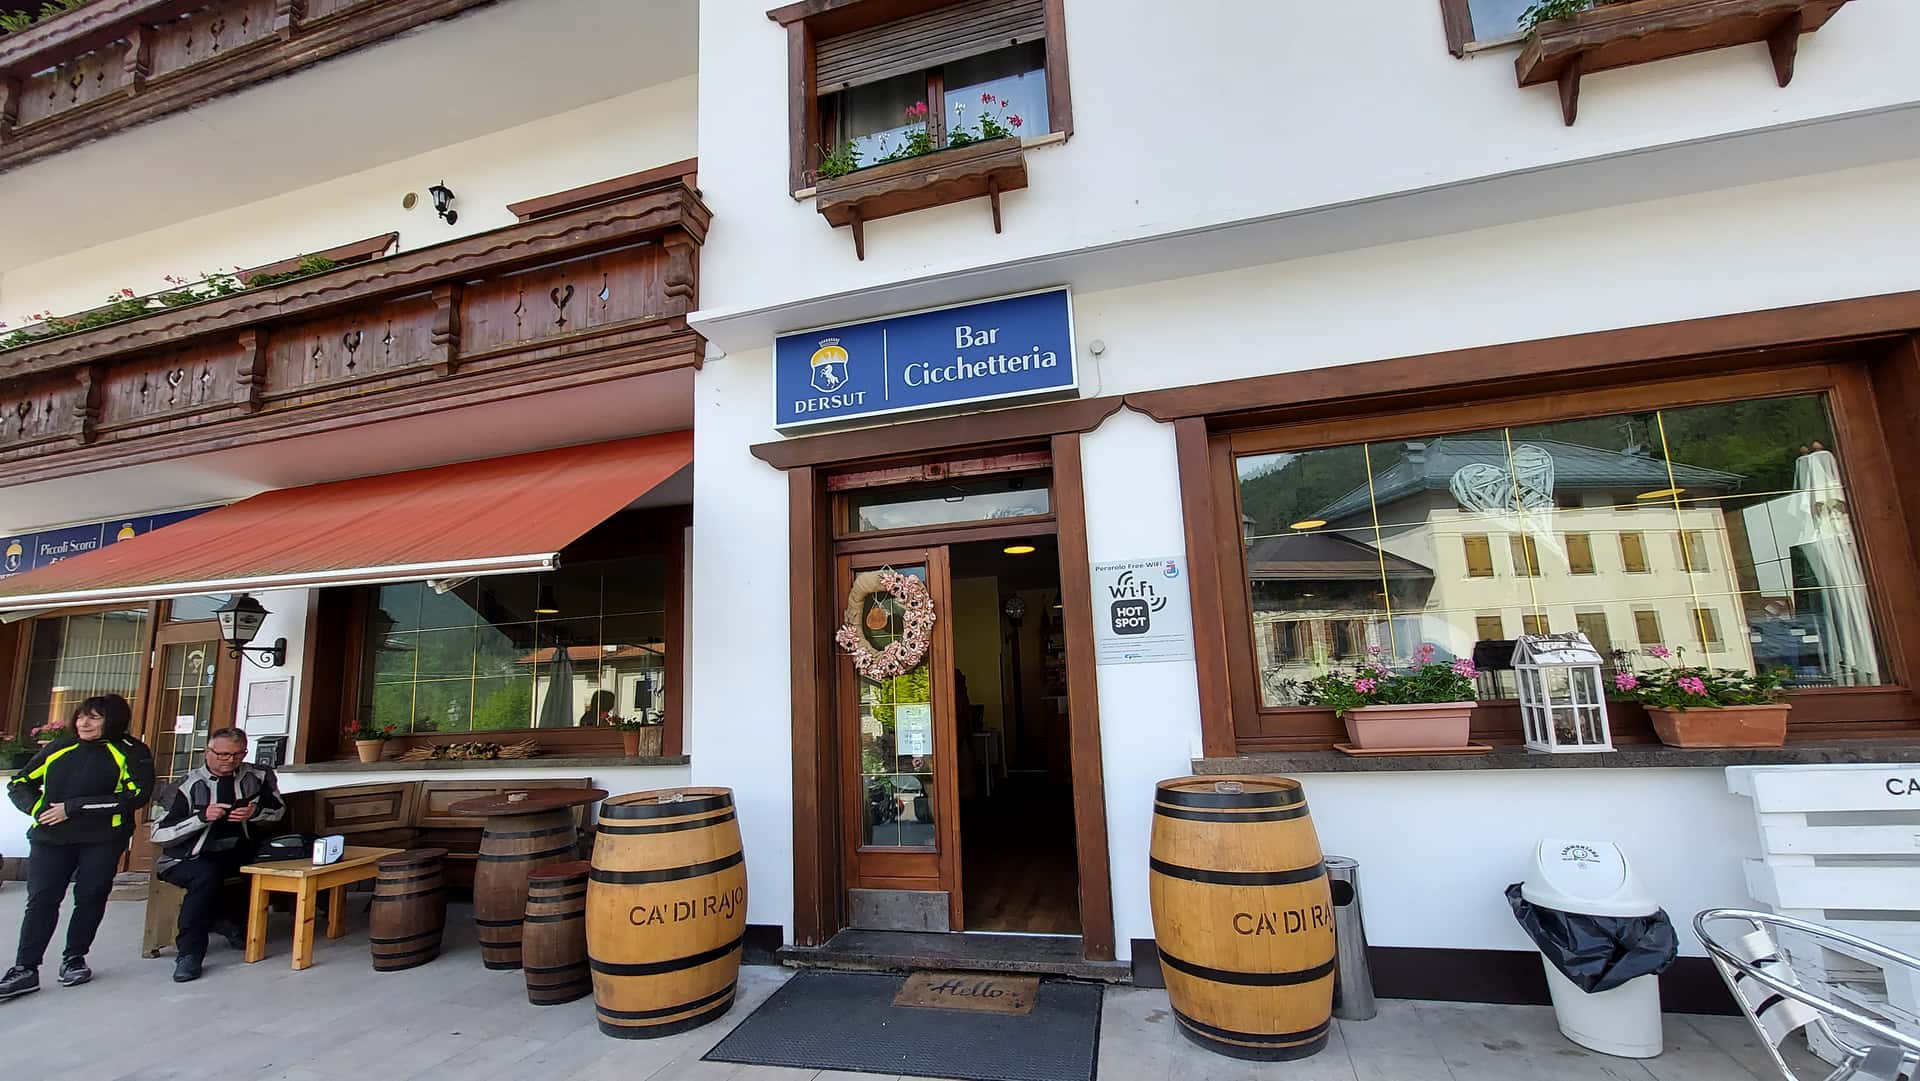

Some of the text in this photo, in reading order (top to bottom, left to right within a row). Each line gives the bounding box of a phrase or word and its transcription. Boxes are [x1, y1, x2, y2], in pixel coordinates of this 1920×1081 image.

[955, 325, 1000, 349] Bar
[904, 346, 1057, 387] Cicchetteria
[795, 391, 866, 414] DERSUT
[40, 537, 97, 556] Piccoli Scorci
[1127, 561, 1144, 570] Free
[1116, 606, 1143, 617] HOT
[1115, 617, 1147, 628] SPOT
[674, 900, 696, 922] DI
[703, 886, 744, 919] RAJO
[1284, 908, 1307, 934] DI
[929, 978, 1004, 998] Hello
